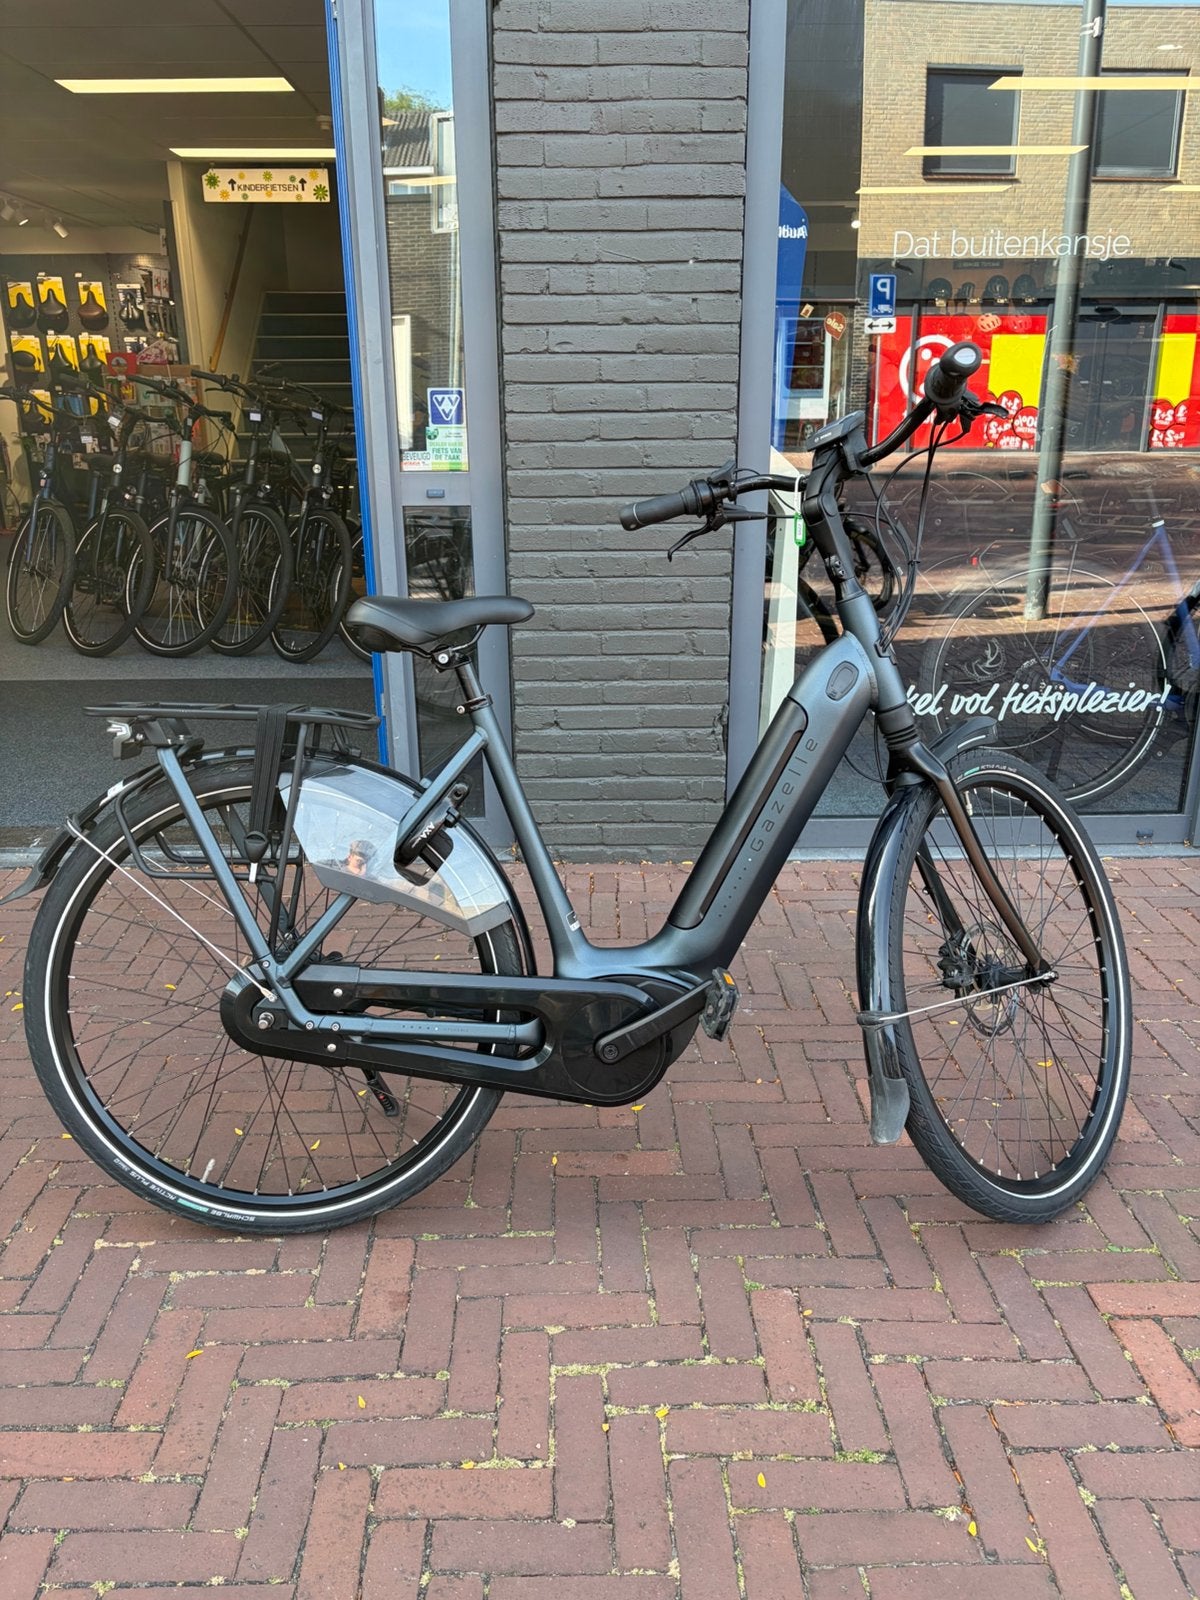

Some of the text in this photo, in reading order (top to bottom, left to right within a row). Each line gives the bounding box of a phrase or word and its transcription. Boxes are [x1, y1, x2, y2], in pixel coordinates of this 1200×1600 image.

[237, 183, 299, 192] KINDERFIETSEN
[892, 228, 1134, 262] Dat buitenkansje.
[950, 683, 1000, 715] vol
[998, 681, 1172, 721] fietsplezier!
[750, 738, 819, 852] Gazelle
[129, 1170, 256, 1222] SCHWALBE ACTIVE PLUS
